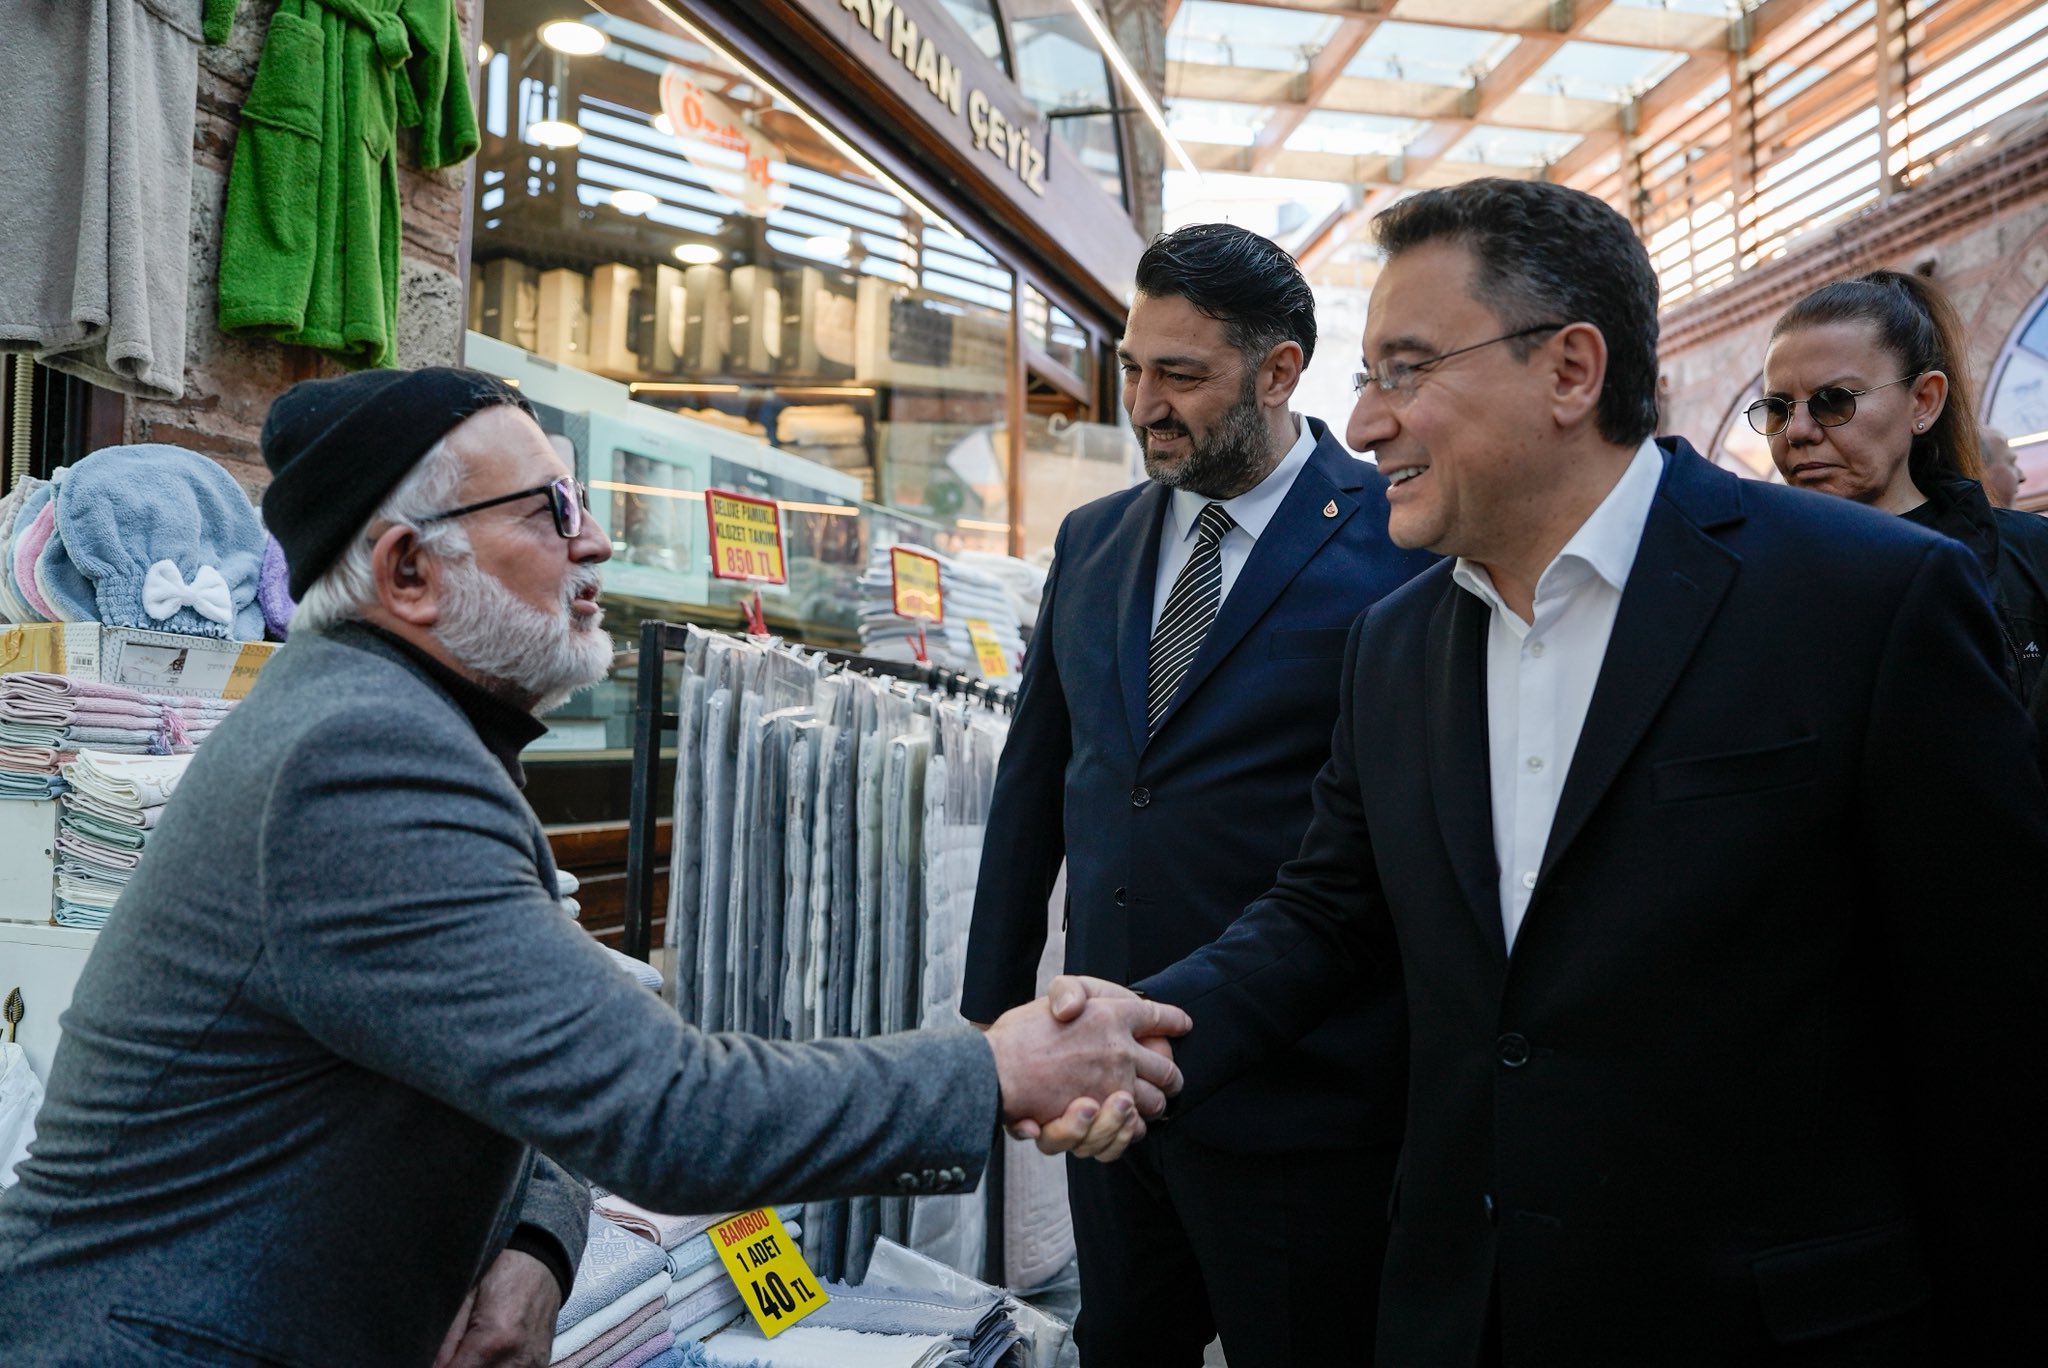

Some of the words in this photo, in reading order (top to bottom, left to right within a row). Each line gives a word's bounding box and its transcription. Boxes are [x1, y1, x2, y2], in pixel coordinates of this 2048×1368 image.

[968, 88, 1046, 198] ÇEYİZ
[714, 499, 741, 519] DELUXE
[716, 522, 746, 542] KLOZET
[727, 547, 754, 575] 850
[757, 550, 775, 577] TL
[718, 1209, 770, 1247] BAMBOO
[736, 1252, 750, 1272] 1
[747, 1235, 782, 1268] ADET
[751, 1271, 796, 1320] 40
[790, 1277, 816, 1303] TL
